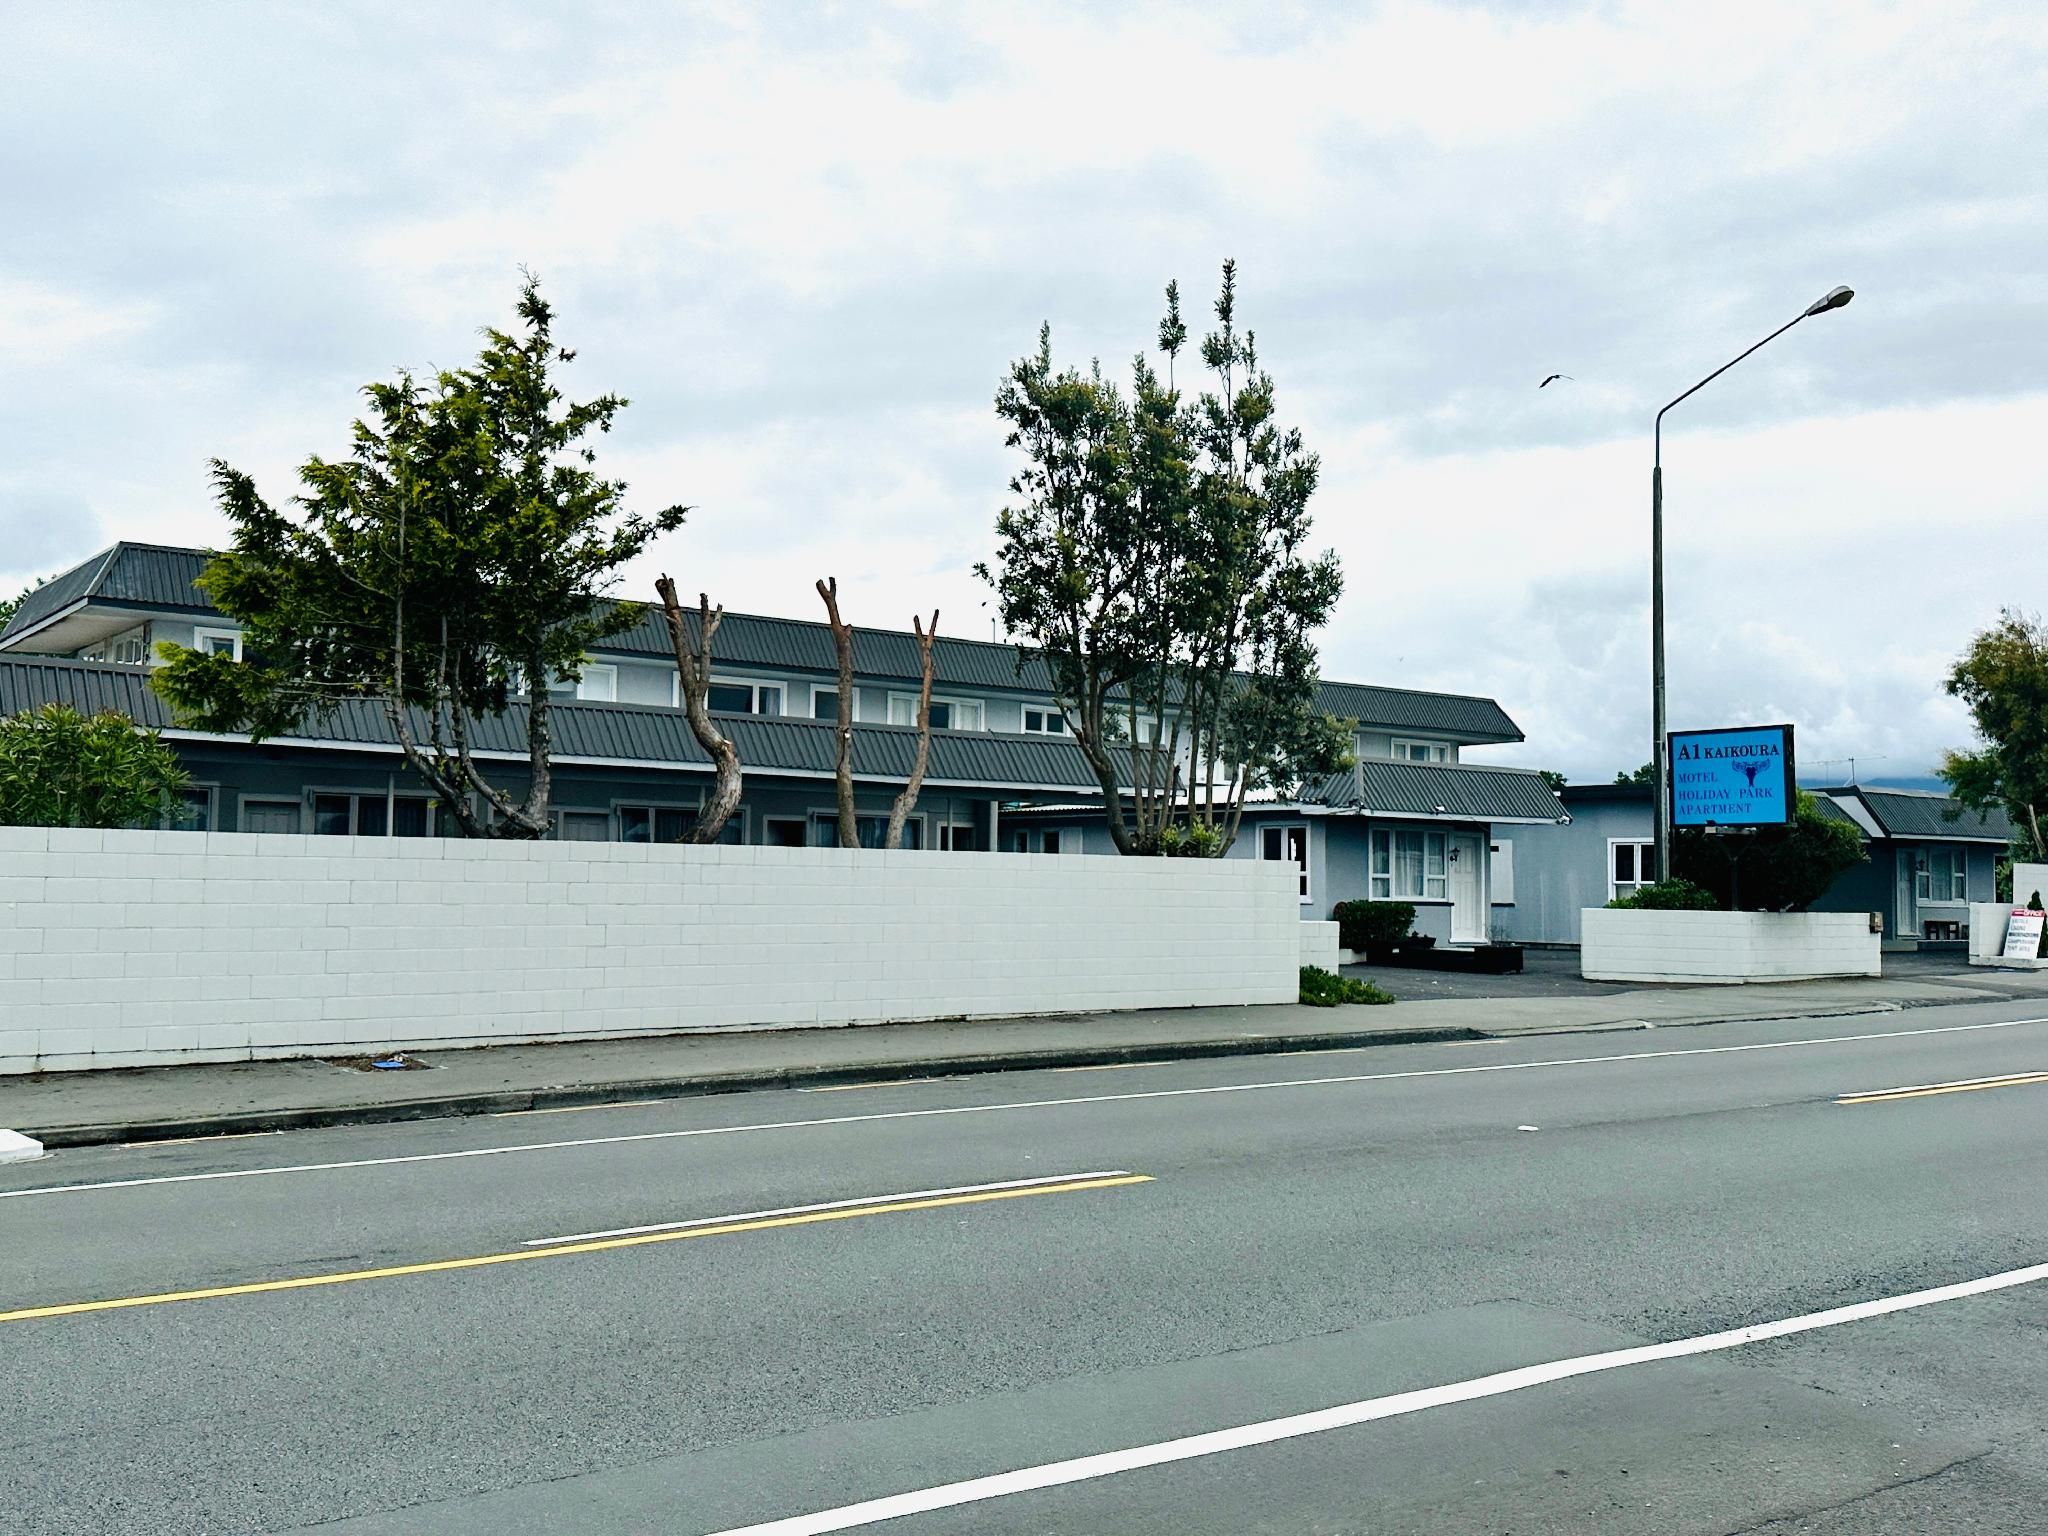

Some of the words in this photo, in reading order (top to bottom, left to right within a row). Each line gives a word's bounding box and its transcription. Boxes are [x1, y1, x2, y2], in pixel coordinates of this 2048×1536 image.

[1679, 744, 1700, 760] A1
[1704, 744, 1779, 759] KAIKOURA
[1679, 772, 1718, 783] MOTEL
[1679, 789, 1730, 800] HOLIDAY
[1740, 787, 1773, 798] PARK
[1680, 803, 1752, 815] APARTMENT
